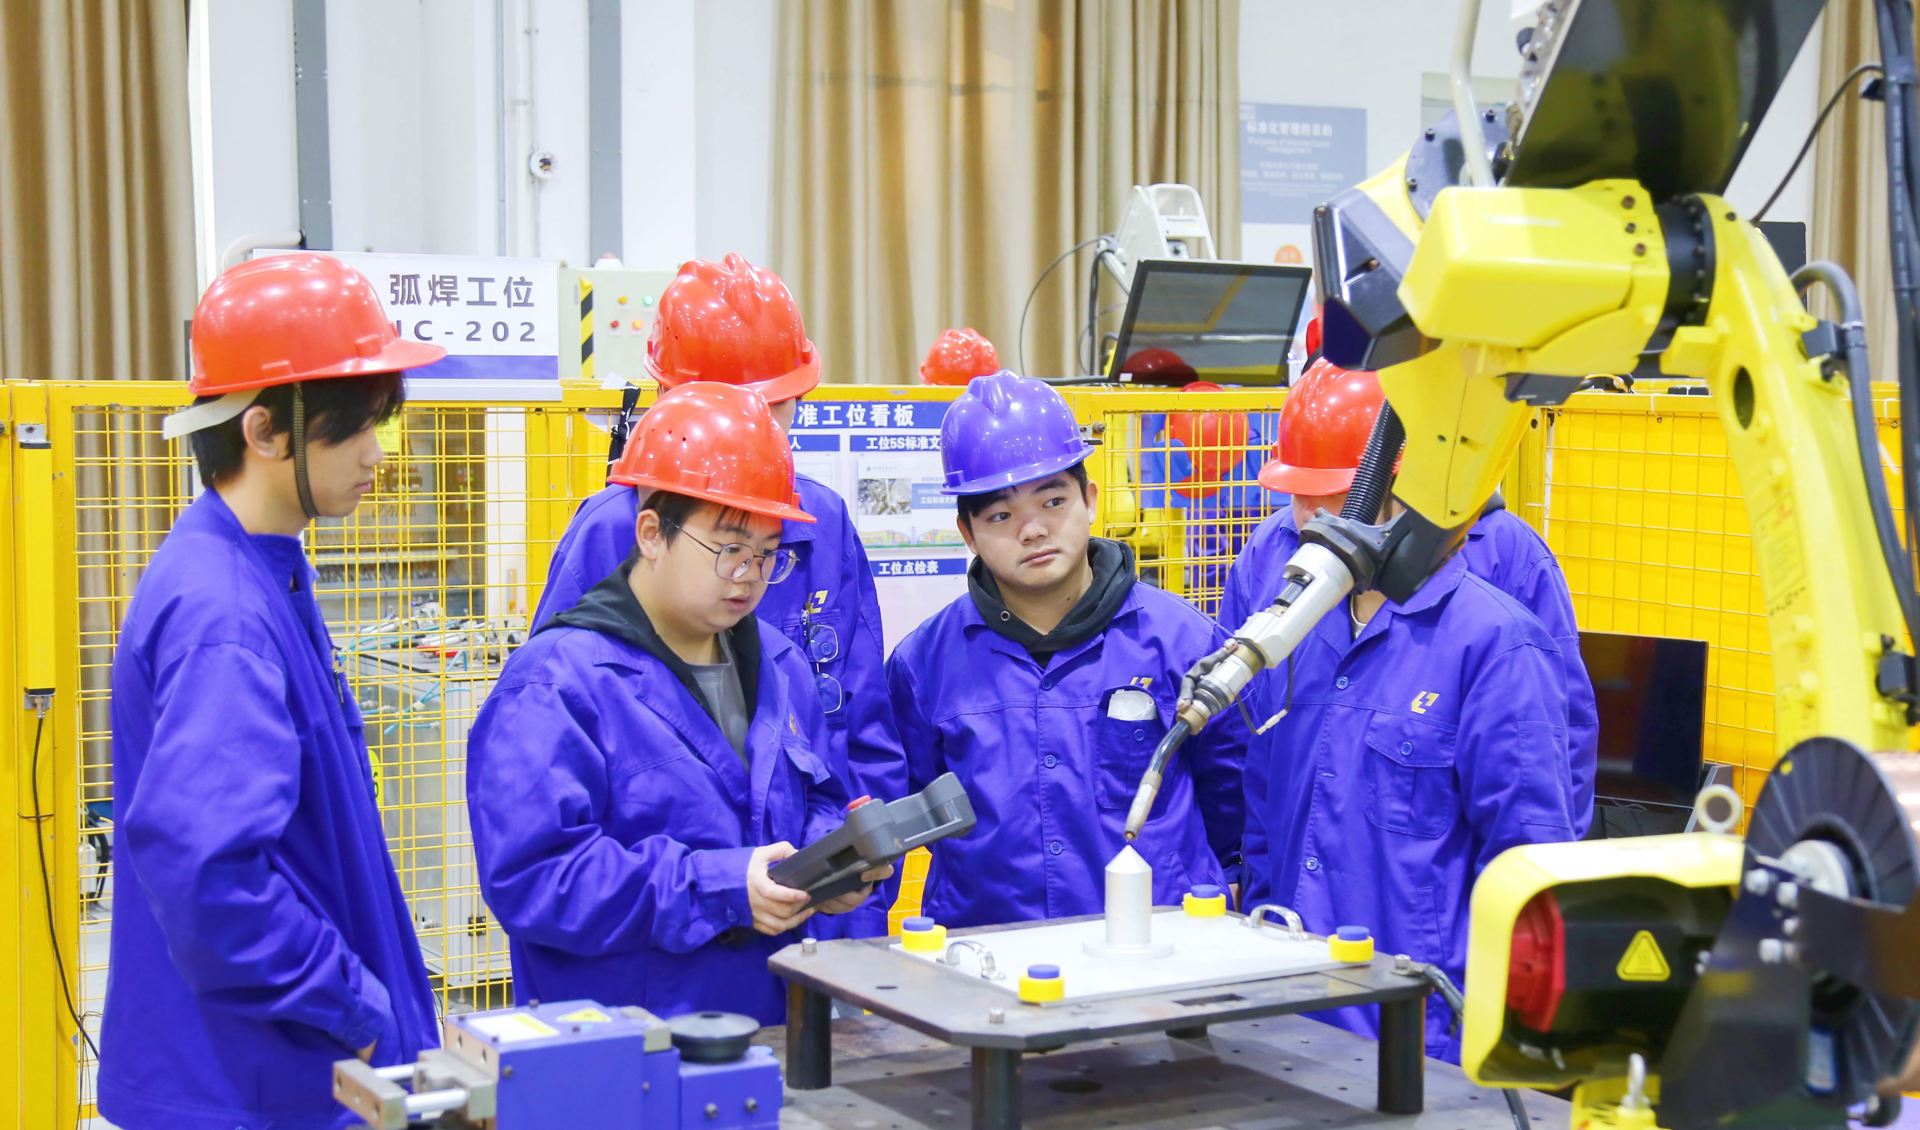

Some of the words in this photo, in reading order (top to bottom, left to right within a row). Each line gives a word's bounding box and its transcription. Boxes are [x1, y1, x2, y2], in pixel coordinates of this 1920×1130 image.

[389, 273, 535, 308] 弧焊工位
[792, 403, 914, 428] 准工位看板
[878, 560, 939, 575] 工位点检表
